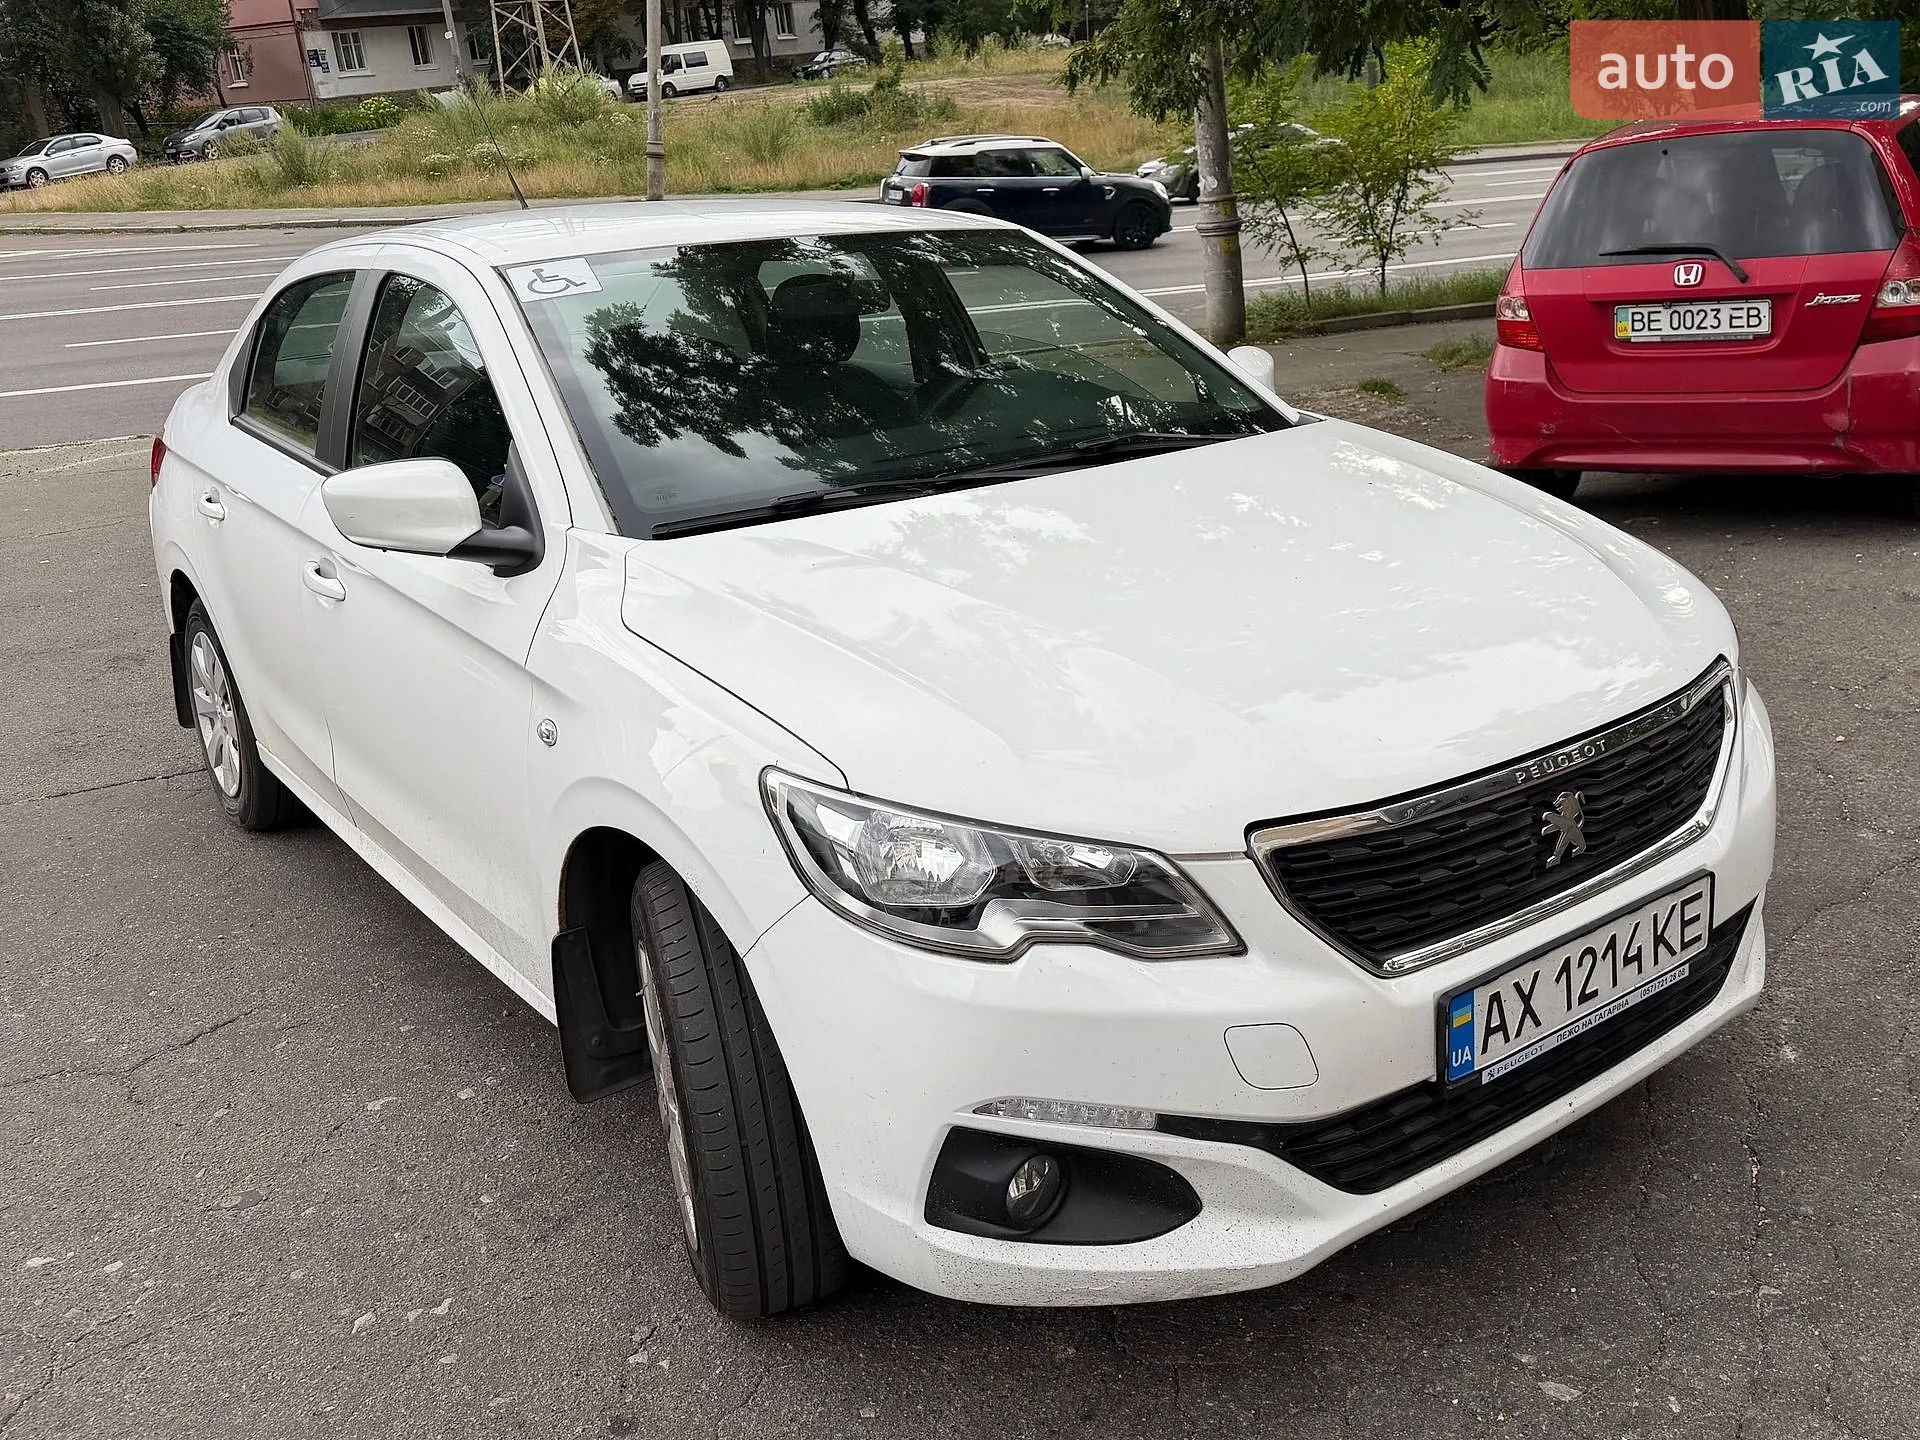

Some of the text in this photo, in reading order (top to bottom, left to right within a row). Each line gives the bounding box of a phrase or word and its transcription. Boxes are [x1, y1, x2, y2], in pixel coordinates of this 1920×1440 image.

[1631, 306, 1762, 332] BE 0023 EB
[1515, 739, 1606, 784] PEUGEOT
[1480, 890, 1704, 1056] AX 1214 KE
[1556, 1024, 1580, 1043] ПЕЖО
[1452, 1045, 1472, 1067] UA
[1496, 1043, 1545, 1074] PEUGEOT
